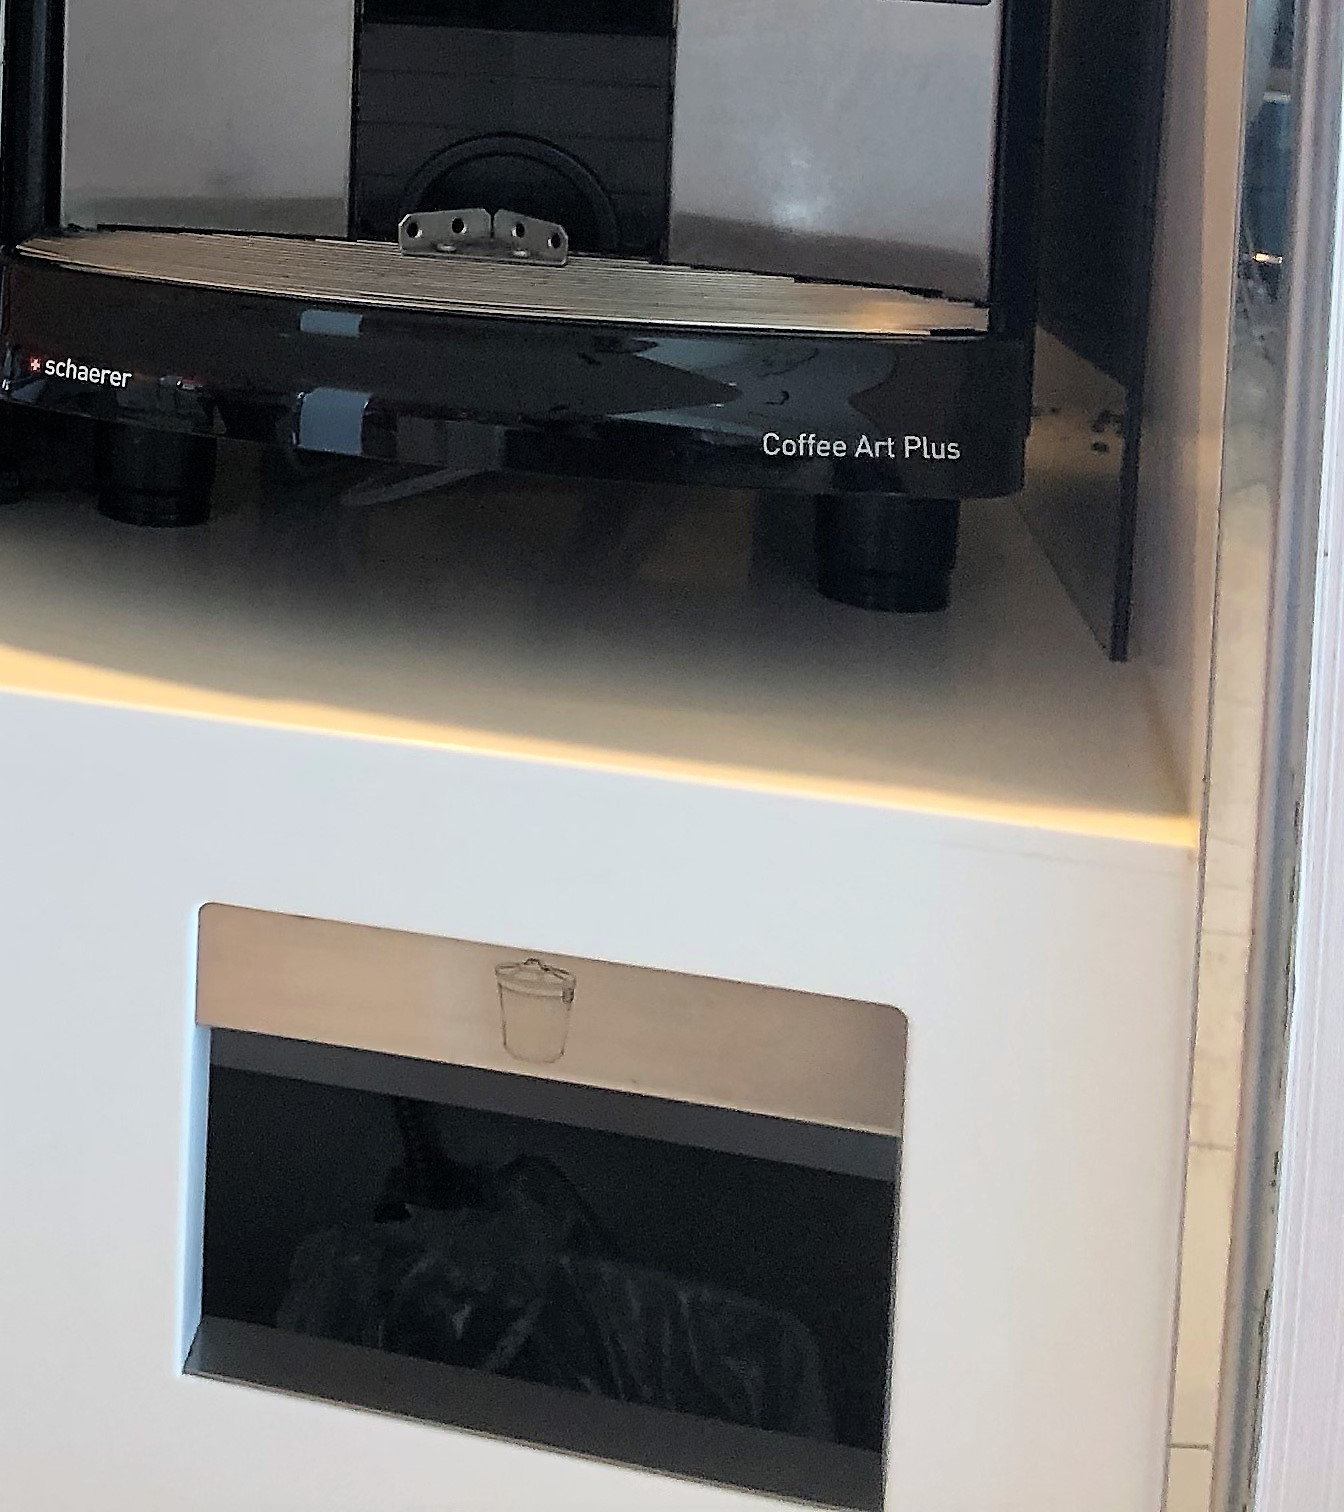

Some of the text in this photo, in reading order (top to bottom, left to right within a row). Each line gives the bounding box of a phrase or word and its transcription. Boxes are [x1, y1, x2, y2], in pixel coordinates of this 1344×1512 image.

[44, 358, 133, 387] schaerer
[762, 432, 961, 459] Coffee Art Plus
